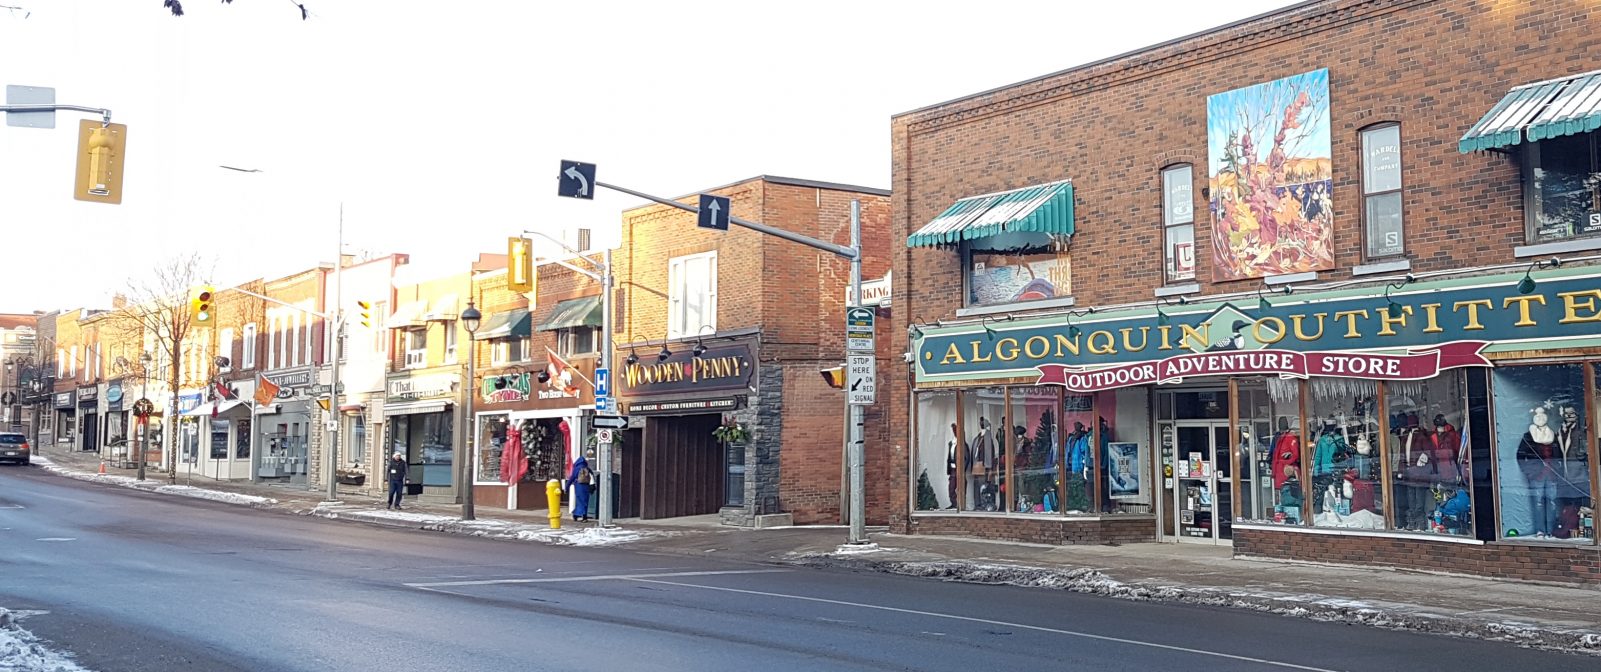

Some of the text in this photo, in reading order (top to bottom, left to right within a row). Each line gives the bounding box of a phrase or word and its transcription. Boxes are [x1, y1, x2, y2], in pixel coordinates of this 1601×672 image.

[940, 322, 1212, 365] ALGONQUIN
[852, 366, 870, 374] HERE
[853, 357, 870, 365] STOP
[624, 355, 743, 388] WOODEN PENNY
[1067, 351, 1401, 390] OUTDOOR ADVENTURE STORE
[596, 373, 606, 391] H
[854, 394, 873, 402] SIGNAL
